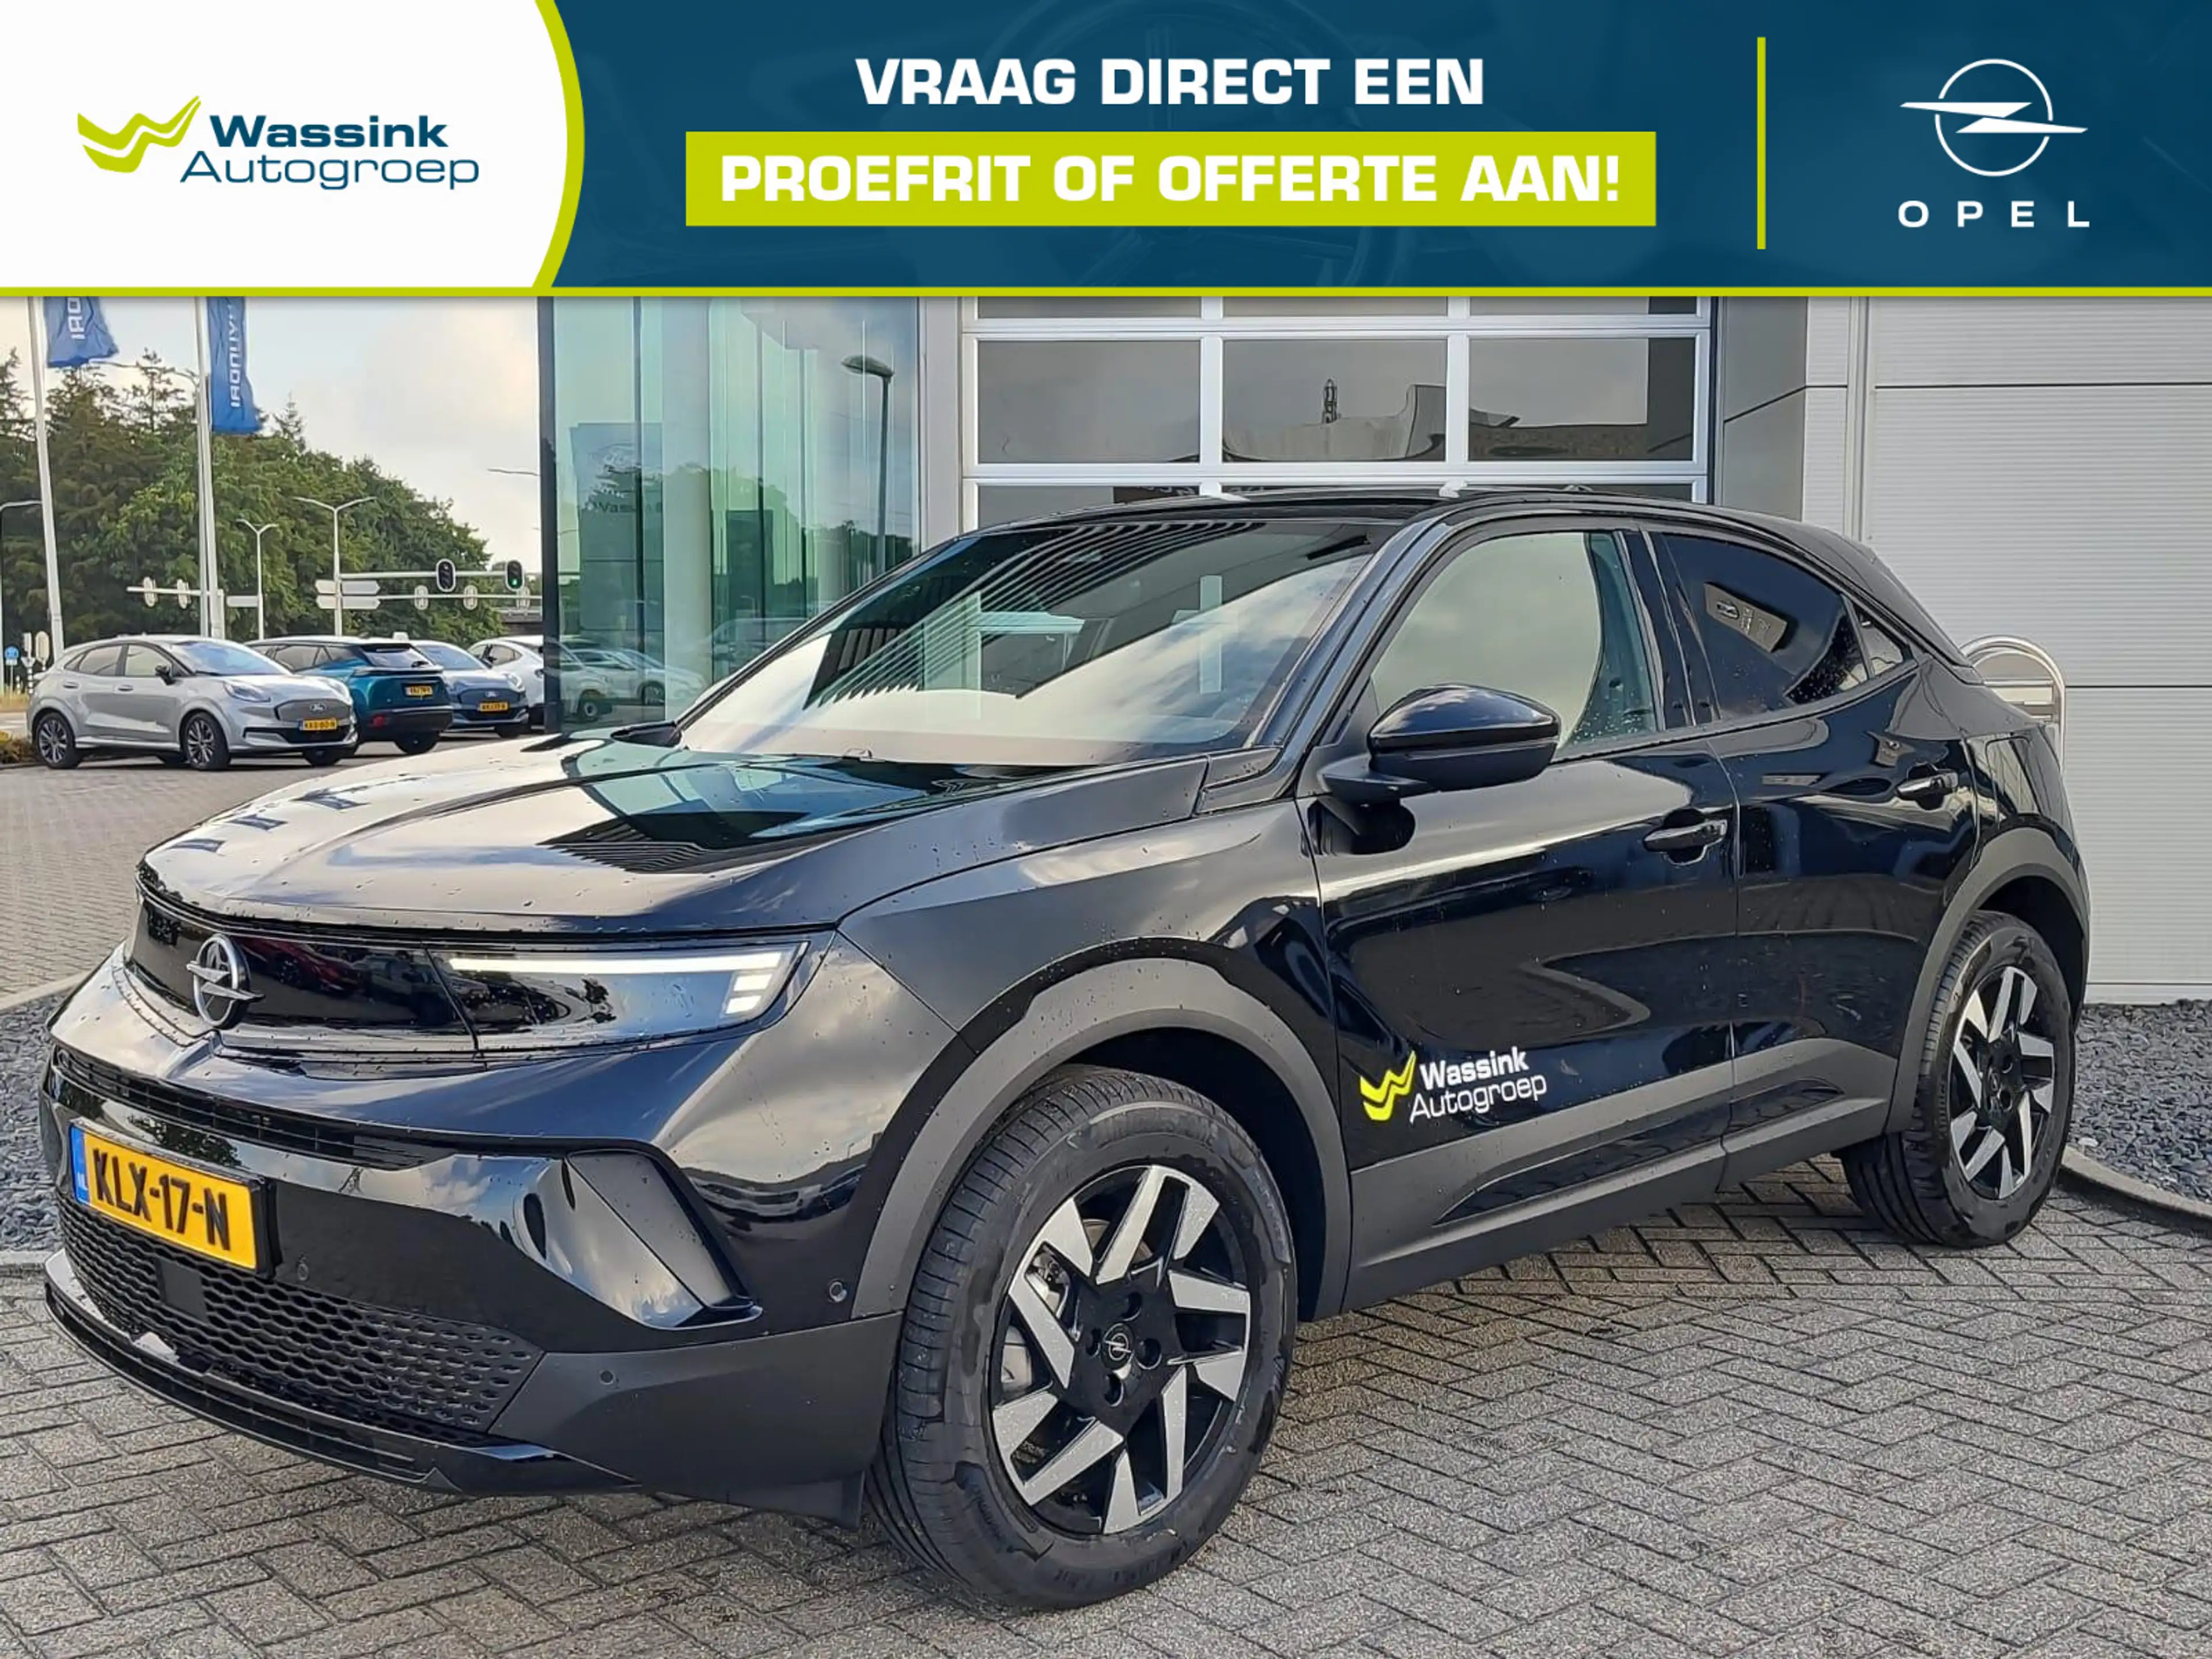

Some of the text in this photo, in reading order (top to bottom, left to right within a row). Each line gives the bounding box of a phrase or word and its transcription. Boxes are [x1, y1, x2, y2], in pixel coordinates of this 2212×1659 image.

[1419, 1046, 1530, 1090] Wassink
[1409, 1074, 1548, 1124] Autogroep
[93, 1148, 230, 1251] KLX-17-N
